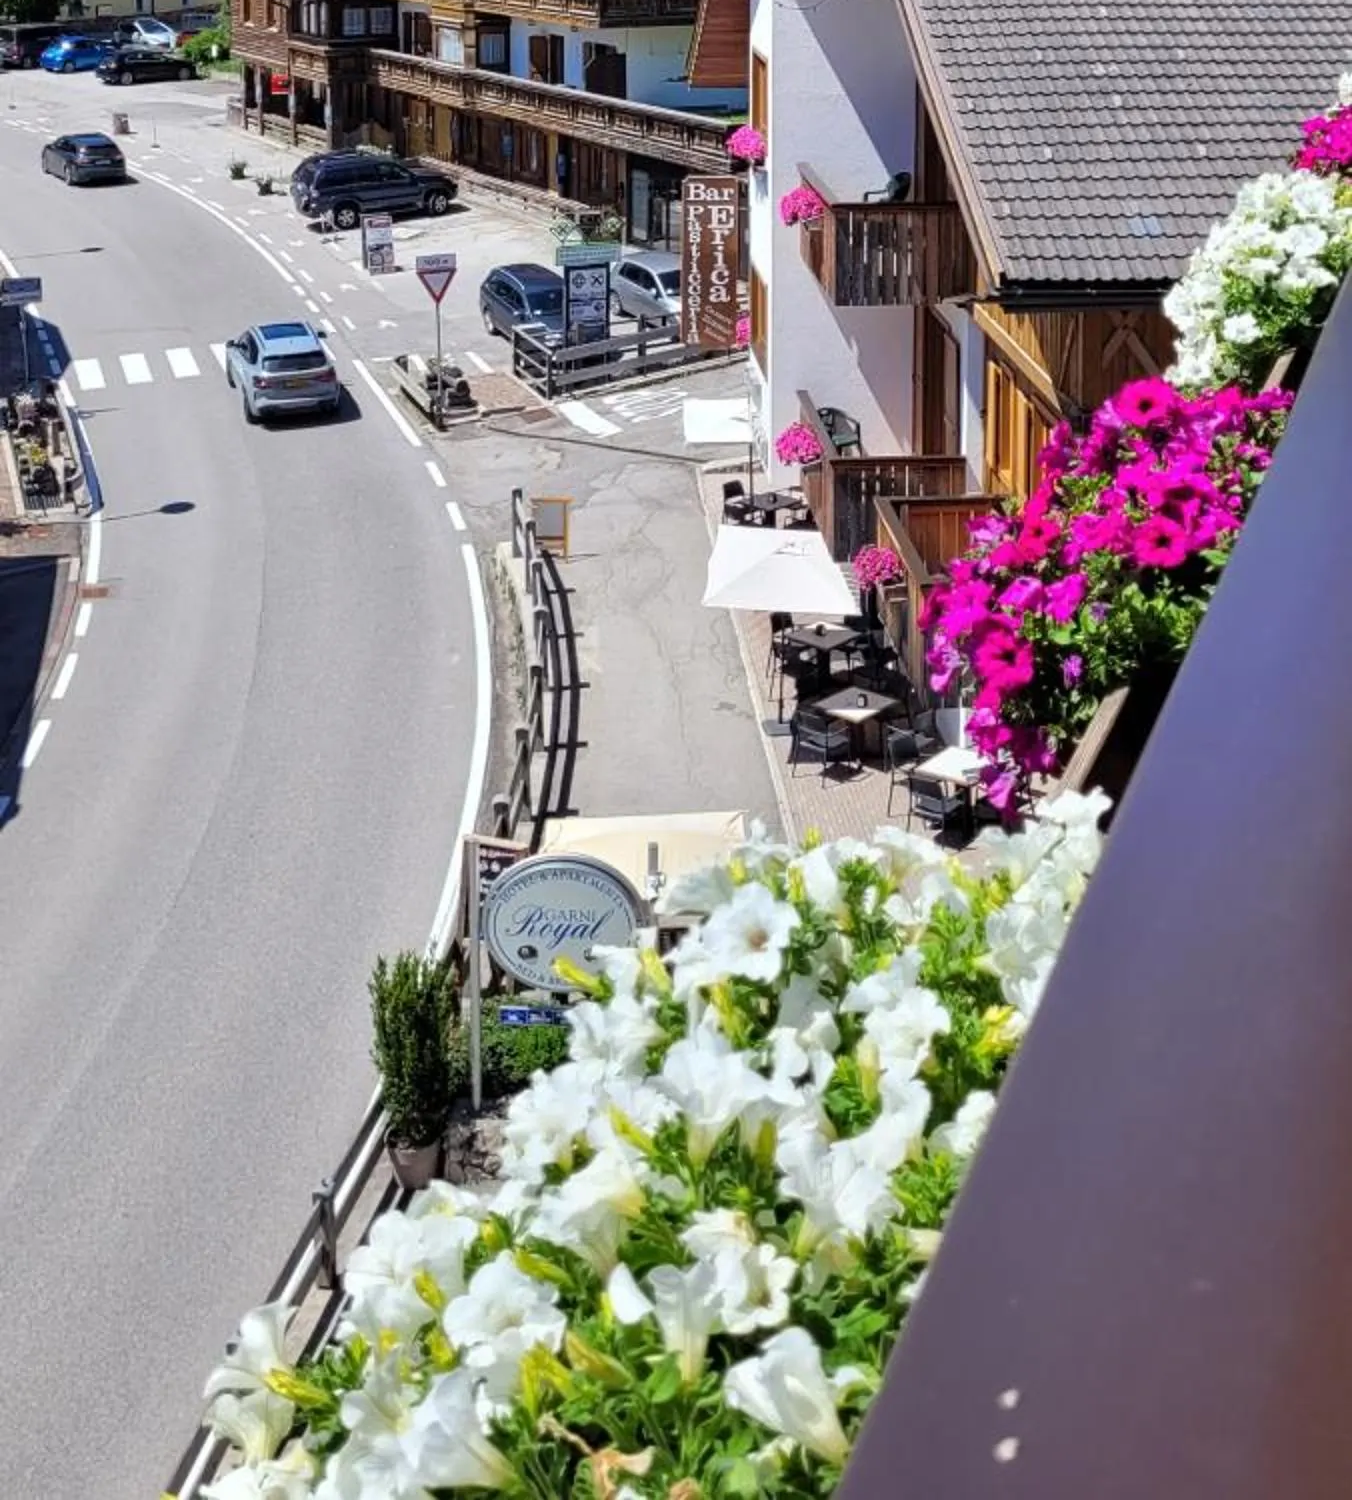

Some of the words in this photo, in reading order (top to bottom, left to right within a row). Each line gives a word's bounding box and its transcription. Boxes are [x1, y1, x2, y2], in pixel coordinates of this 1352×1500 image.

[686, 183, 734, 200] Bar
[708, 205, 735, 303] Erica
[505, 904, 615, 950] Royal
[545, 908, 596, 922] GARNI
